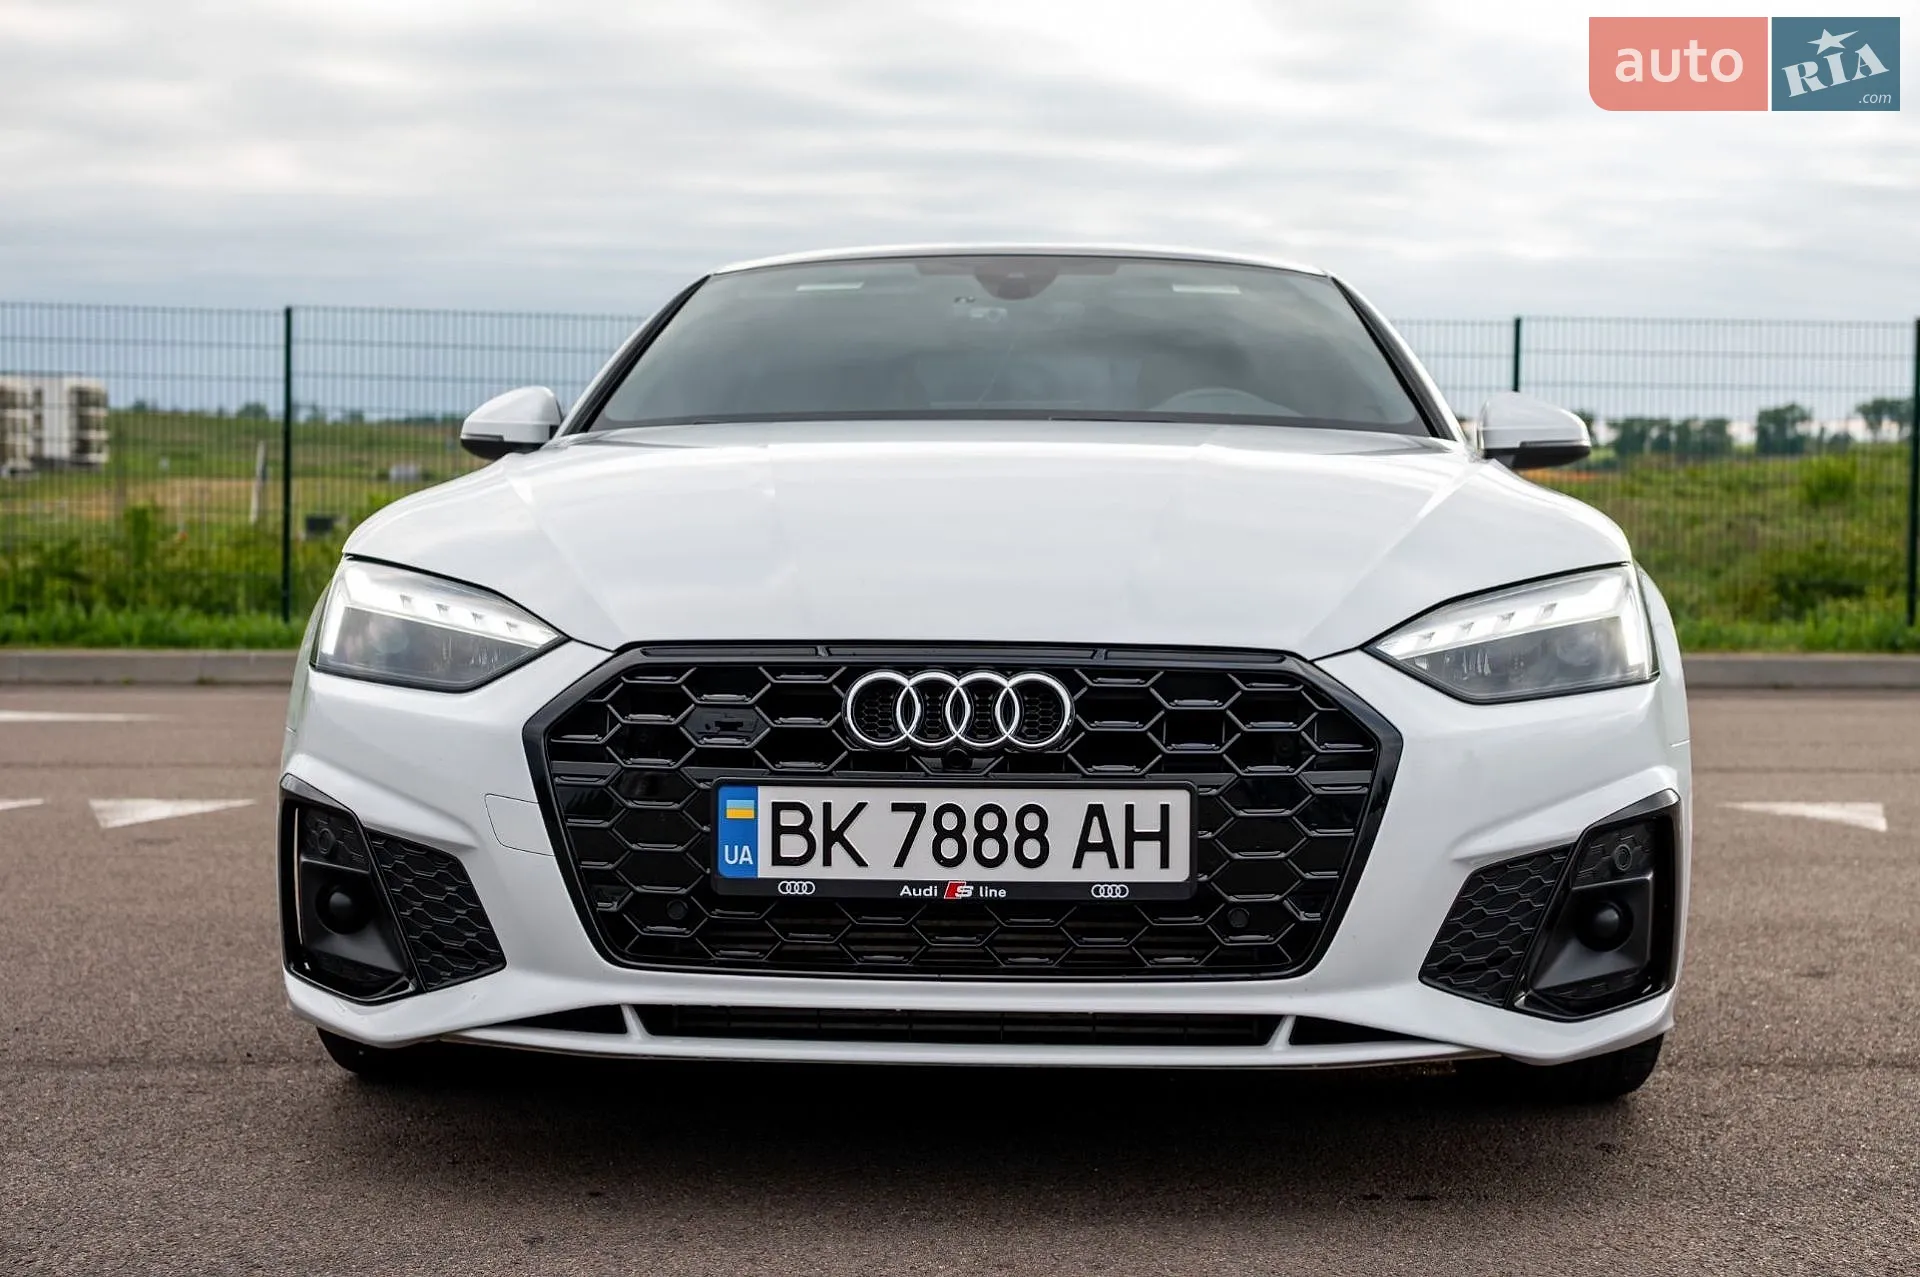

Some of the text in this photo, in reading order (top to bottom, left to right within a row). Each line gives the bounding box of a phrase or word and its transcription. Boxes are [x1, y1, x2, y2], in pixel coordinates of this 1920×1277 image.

[770, 801, 1170, 870] BK 7888 AH
[724, 844, 753, 866] UA
[899, 885, 938, 897] Audi
[979, 886, 1007, 898] line
